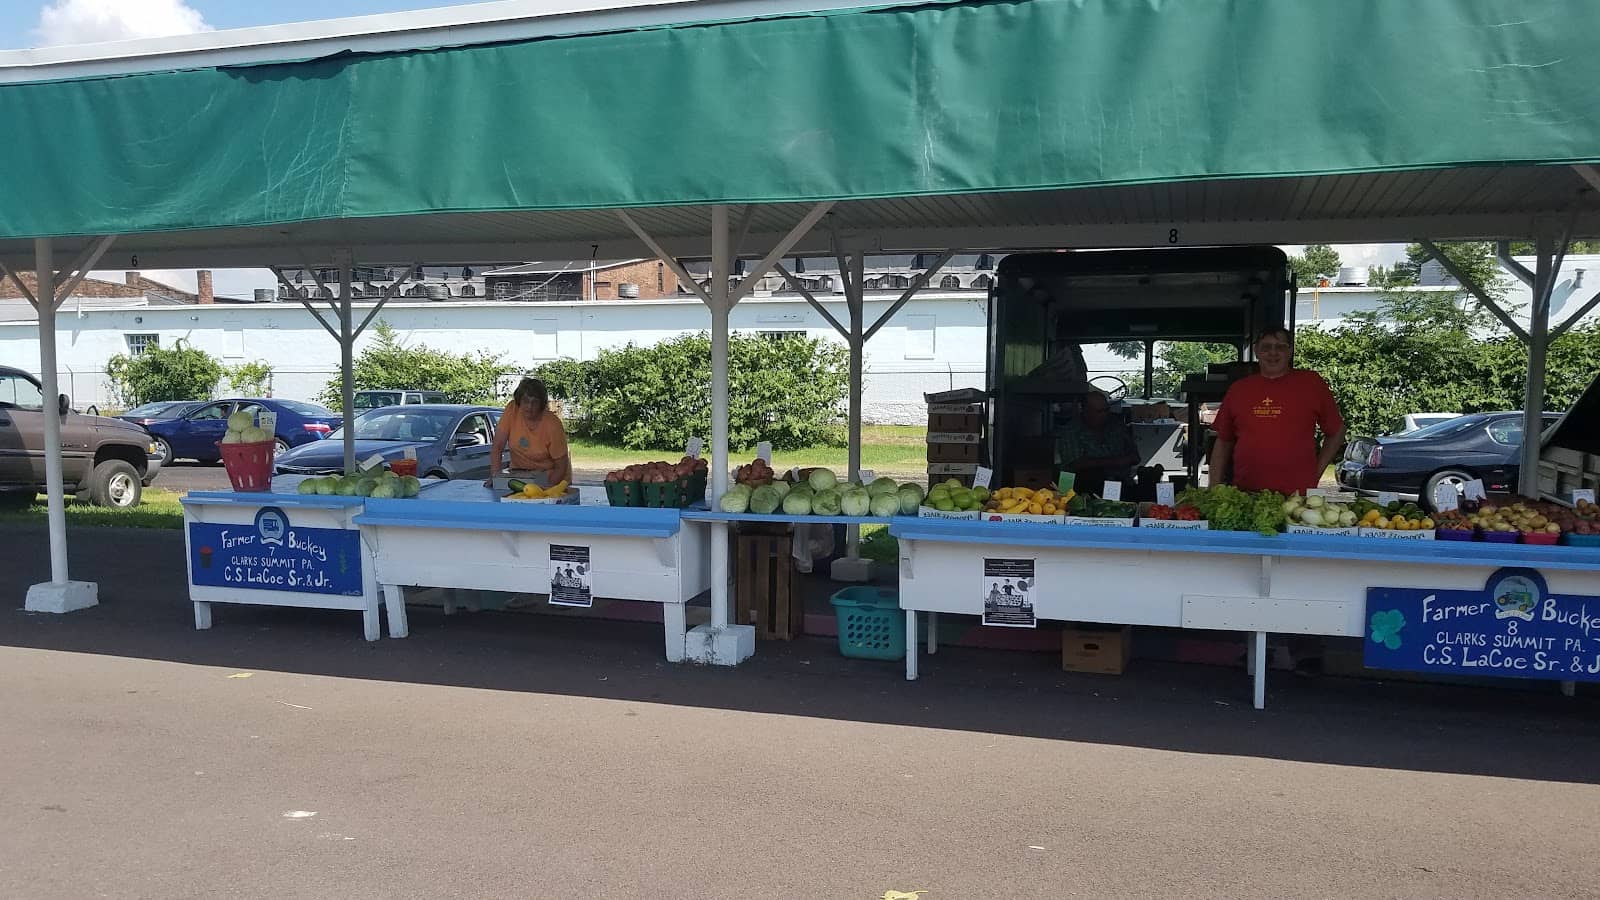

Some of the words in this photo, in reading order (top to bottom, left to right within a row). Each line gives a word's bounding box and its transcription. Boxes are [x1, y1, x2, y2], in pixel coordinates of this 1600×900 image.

[1169, 228, 1178, 244] 8
[591, 244, 599, 258] 7
[131, 254, 138, 267] 6
[221, 530, 256, 549] Farmer
[288, 531, 327, 561] Buckey
[269, 546, 276, 556] 7
[231, 556, 258, 566] CLARKS
[261, 556, 296, 569] SUMMIT
[247, 568, 284, 584] LaCoe
[287, 570, 306, 587] Sr.
[315, 570, 333, 588] Jr.
[1422, 594, 1491, 623] Farmer
[1542, 598, 1600, 642] Bucke
[1507, 620, 1518, 636] 8
[1436, 631, 1487, 646] CLARKS
[1493, 634, 1556, 650] SUMMIT
[1565, 638, 1586, 653] PA.
[1423, 644, 1457, 665] C.S.
[1462, 646, 1528, 669] LaCoe
[1533, 651, 1565, 671] Sr.
[1570, 655, 1584, 673] &
